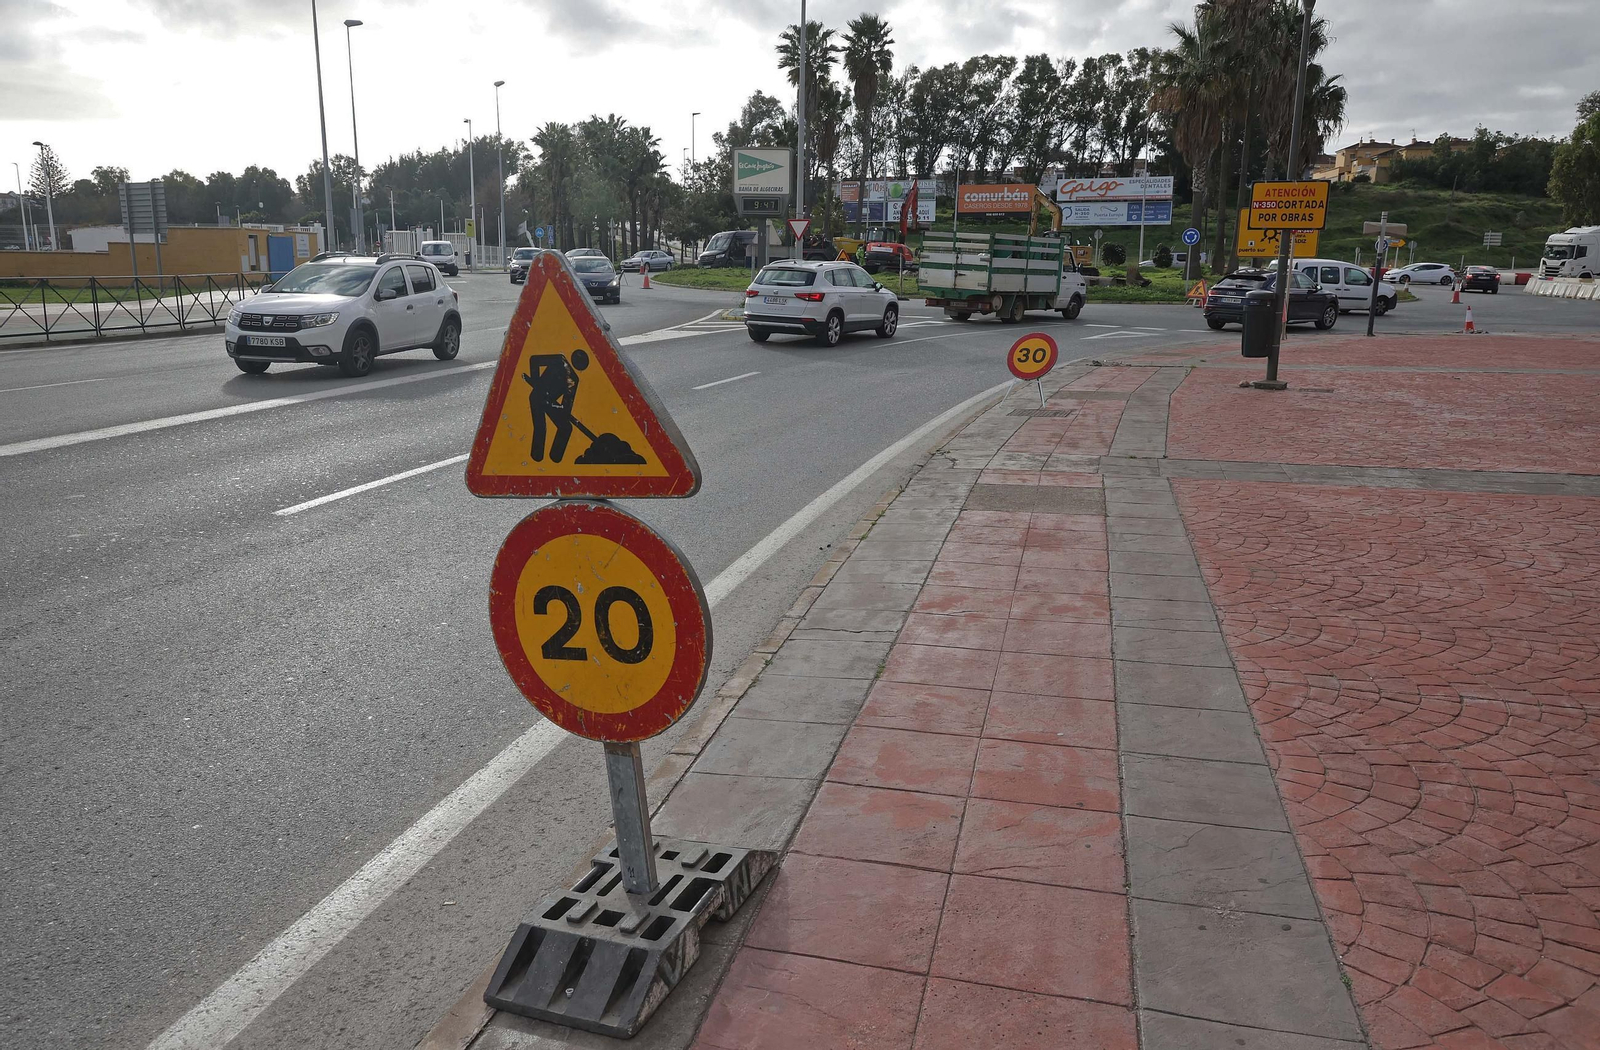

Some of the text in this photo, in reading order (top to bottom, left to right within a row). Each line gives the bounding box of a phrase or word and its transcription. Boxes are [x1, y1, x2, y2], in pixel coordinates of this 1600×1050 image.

[964, 187, 1028, 202] comurbán
[1265, 186, 1316, 197] ATENCIÓN
[1278, 200, 1324, 209] CORTADA
[1258, 213, 1314, 222] POR OBRAS
[1017, 348, 1046, 363] 30
[533, 585, 654, 664] 20
